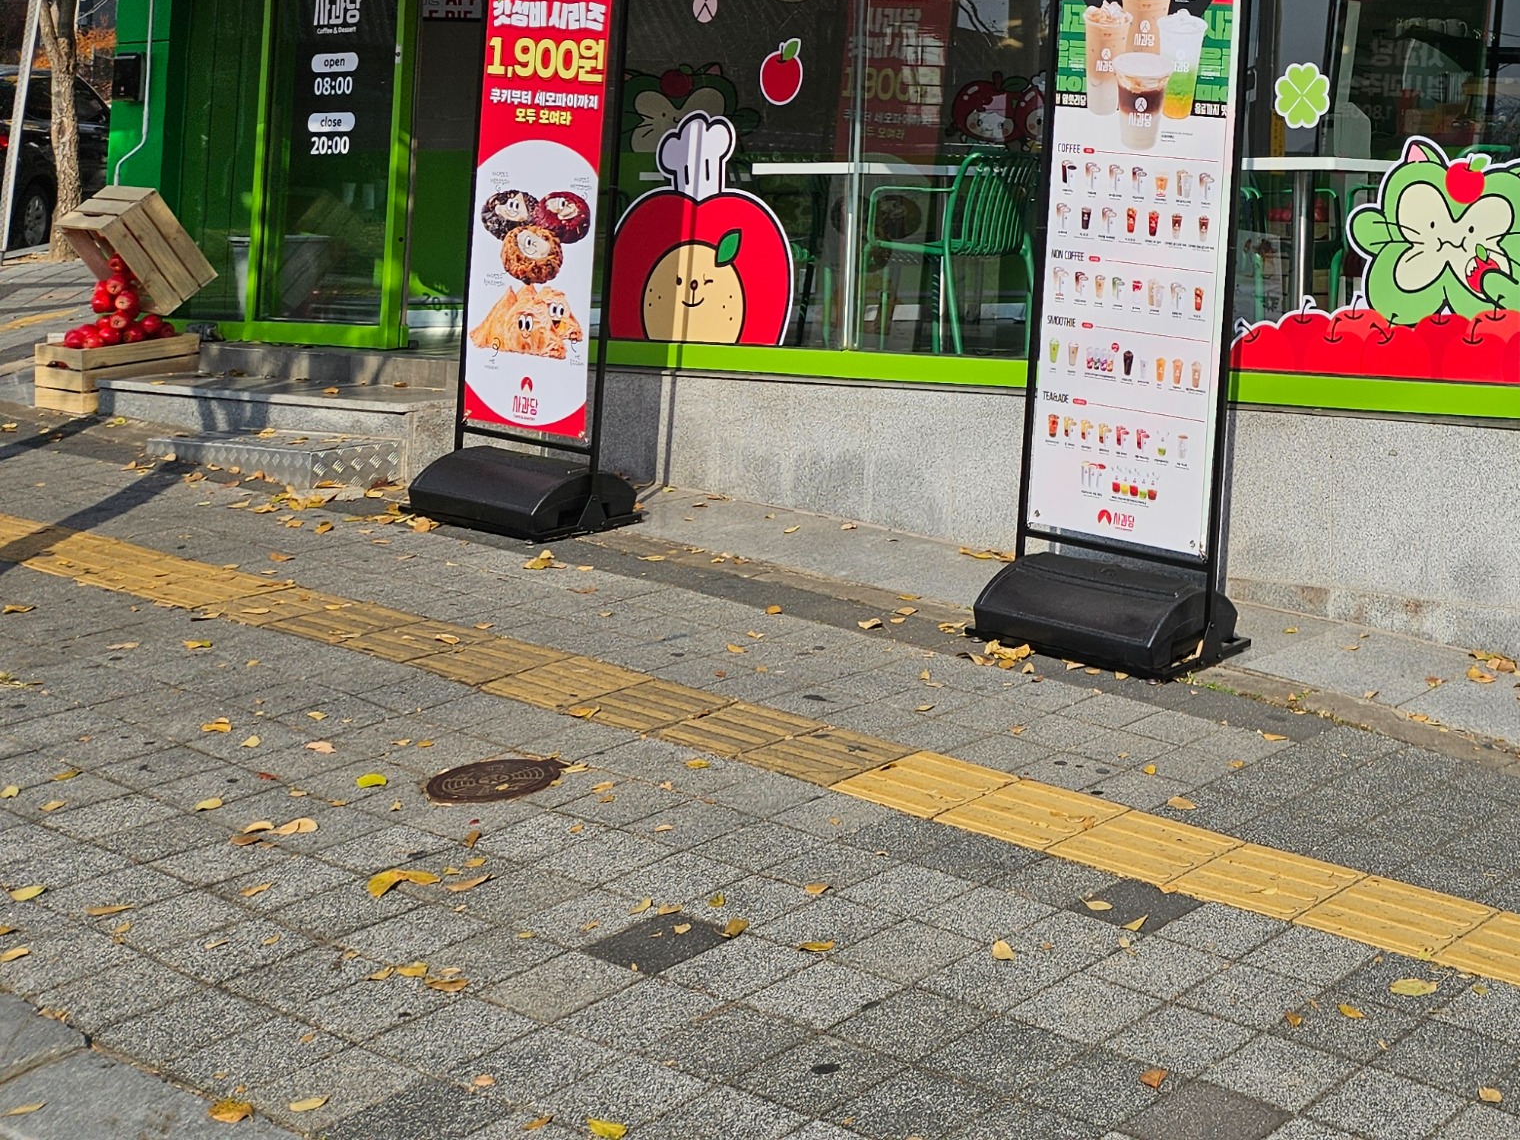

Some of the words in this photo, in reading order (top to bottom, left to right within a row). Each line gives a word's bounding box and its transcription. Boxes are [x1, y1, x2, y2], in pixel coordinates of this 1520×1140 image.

[548, 1, 606, 31] 시리즈
[1133, 33, 1155, 47] 사과당
[323, 56, 345, 69] open
[487, 36, 606, 82] 1,900원
[314, 76, 353, 95] 08:00
[490, 88, 531, 105] 쿠키부터
[534, 91, 599, 109] 세모파이까지
[320, 115, 342, 128] close
[515, 108, 536, 124] 모두
[539, 109, 572, 125] 모여라
[1128, 112, 1153, 128] 사과당
[310, 136, 350, 155] 20:00
[1057, 143, 1081, 154] COFFEE
[1050, 249, 1064, 259] NON
[1064, 250, 1085, 262] COFFEE
[1047, 315, 1076, 328] SMOOTHIE
[513, 395, 538, 415] 사과당
[1042, 391, 1069, 404] TEA&ADE
[1113, 512, 1134, 528] 사과당
